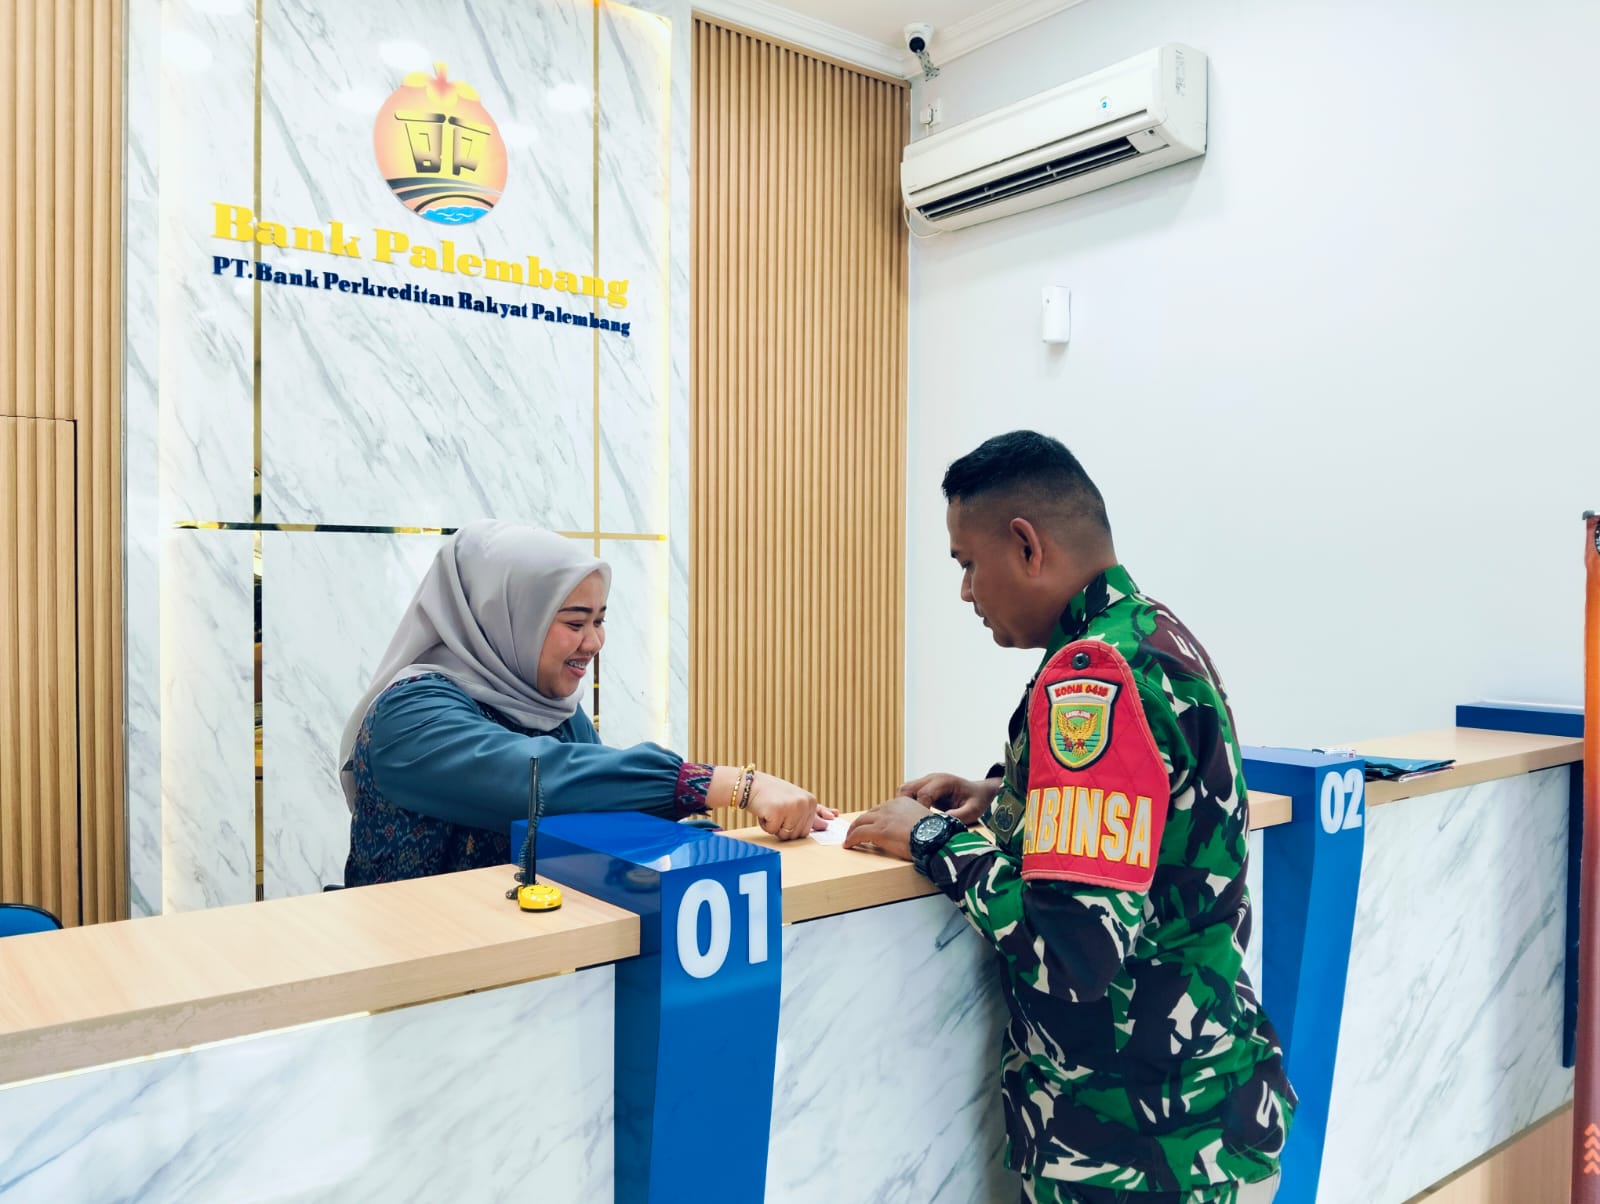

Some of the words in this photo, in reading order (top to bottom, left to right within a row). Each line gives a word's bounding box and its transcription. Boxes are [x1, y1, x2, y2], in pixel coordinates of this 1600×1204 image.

[211, 202, 362, 258] Bank
[372, 228, 630, 309] Palembang
[322, 271, 454, 308] Perkreditan
[458, 291, 527, 318] Rakyat
[531, 302, 631, 337] Palembang
[1320, 768, 1364, 834] 02
[677, 870, 768, 979] 01
